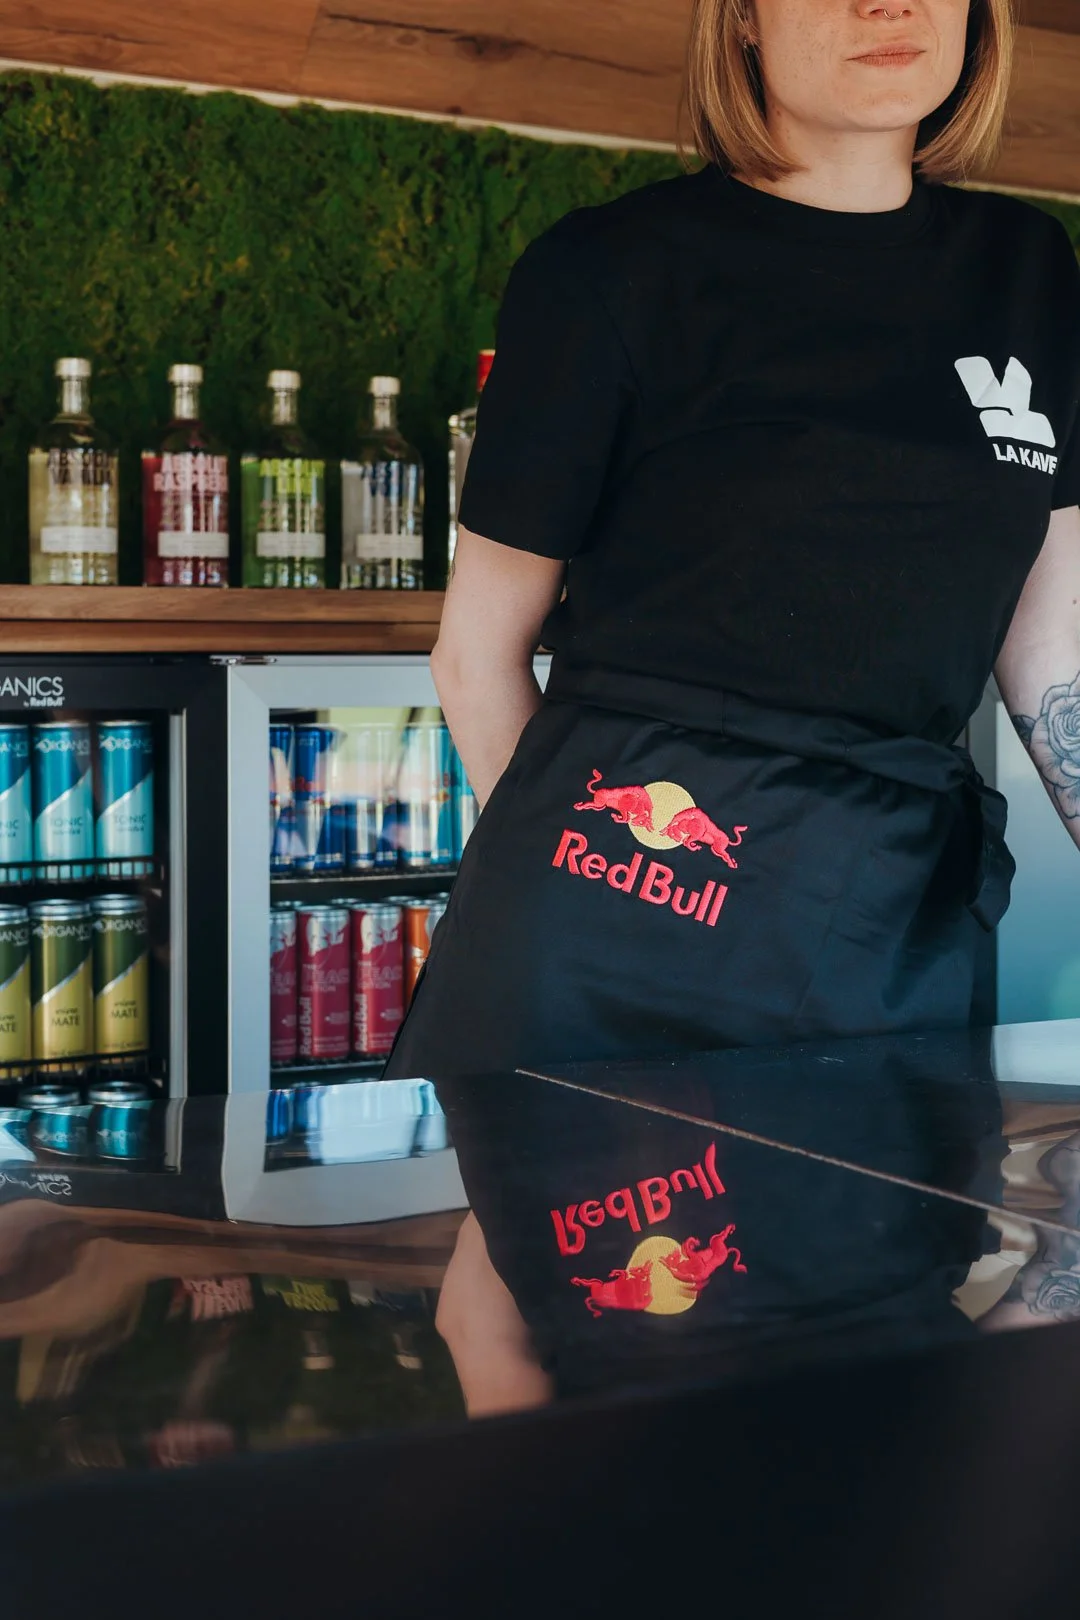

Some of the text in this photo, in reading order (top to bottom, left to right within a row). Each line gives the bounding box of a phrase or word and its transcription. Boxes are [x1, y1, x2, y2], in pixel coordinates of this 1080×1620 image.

[992, 443, 1058, 475] LA KAVE
[0, 676, 64, 697] ANICS
[552, 828, 729, 927] Red Bull
[52, 1013, 80, 1027] MATE
[110, 1007, 138, 1020] MATE
